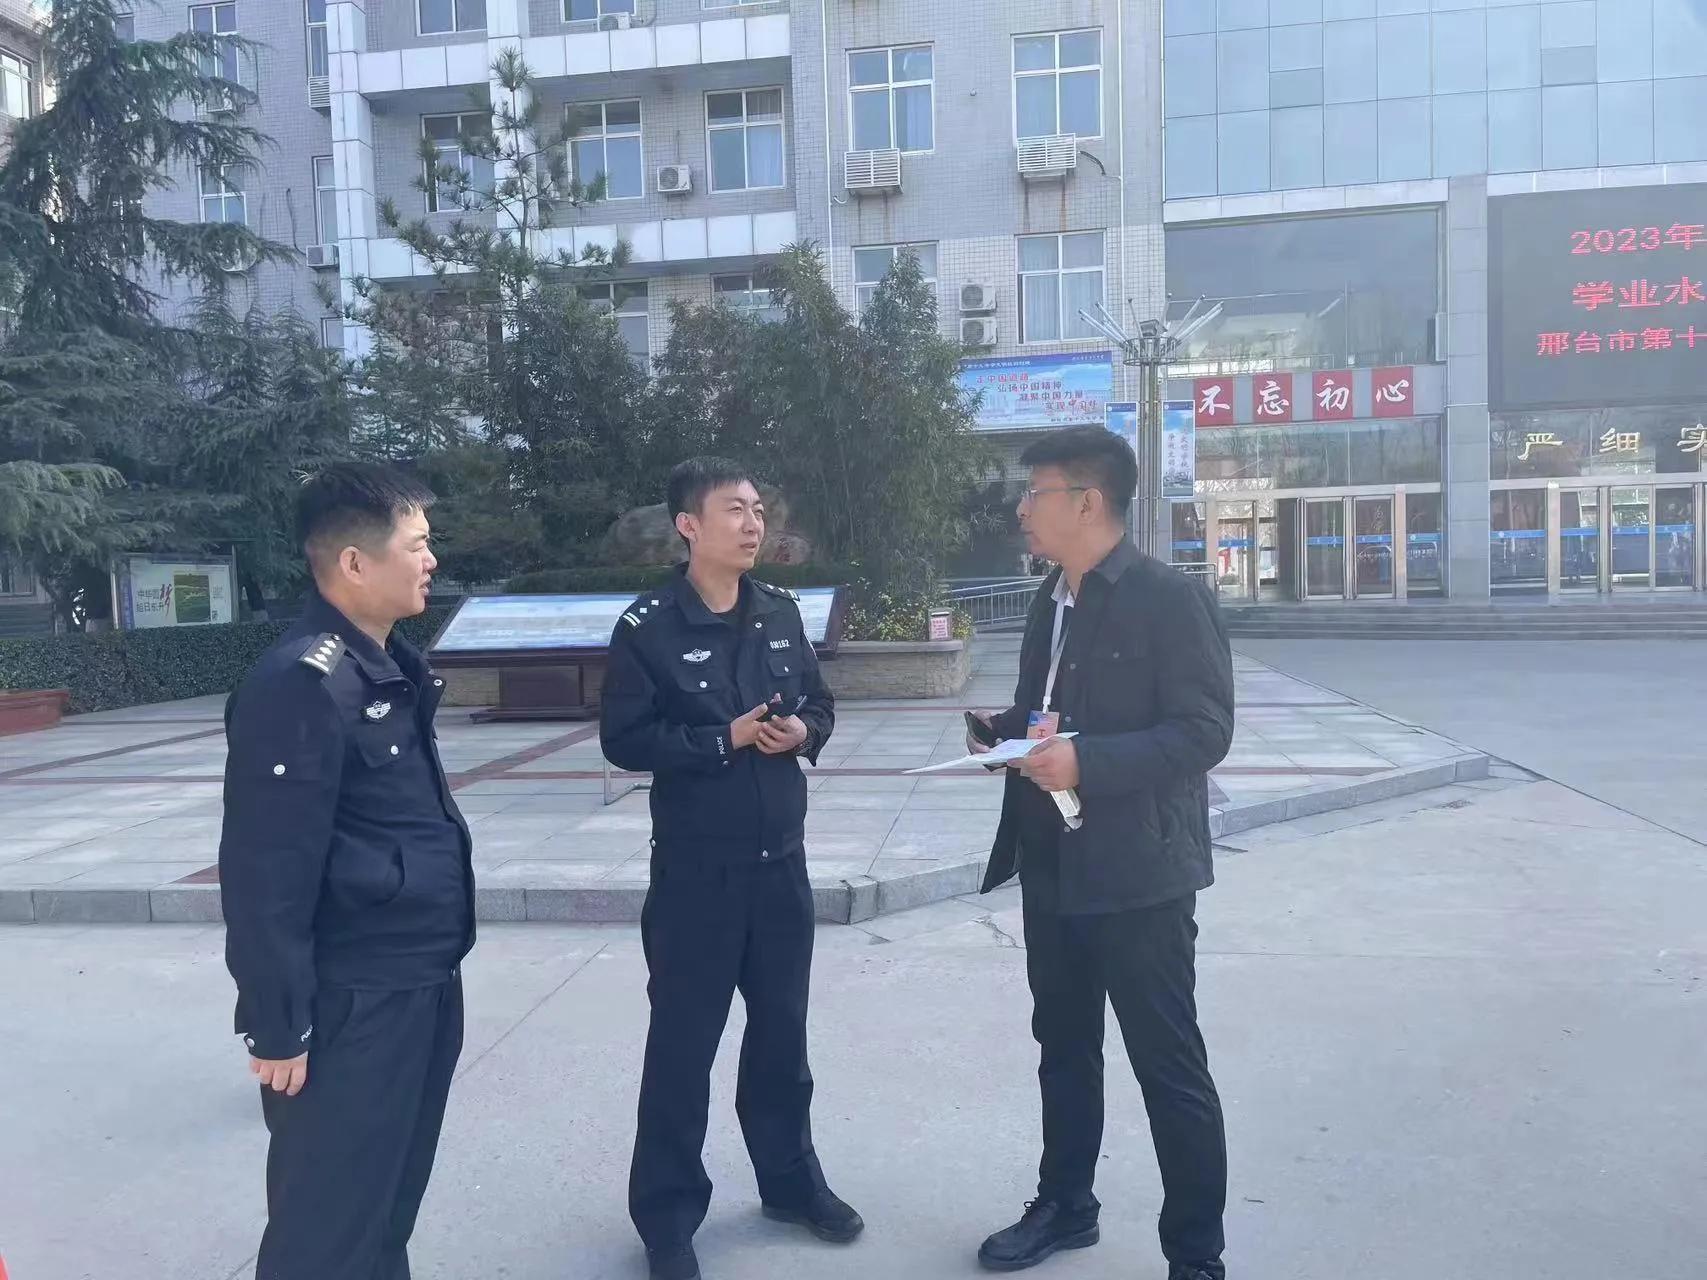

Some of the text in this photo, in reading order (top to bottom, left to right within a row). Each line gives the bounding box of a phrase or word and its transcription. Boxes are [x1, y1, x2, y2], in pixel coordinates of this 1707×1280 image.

[1570, 222, 1707, 254] 2023年
[1572, 276, 1706, 311] 学业水
[1536, 324, 1707, 356] 邢台市第十
[1198, 378, 1410, 416] 不忘初心
